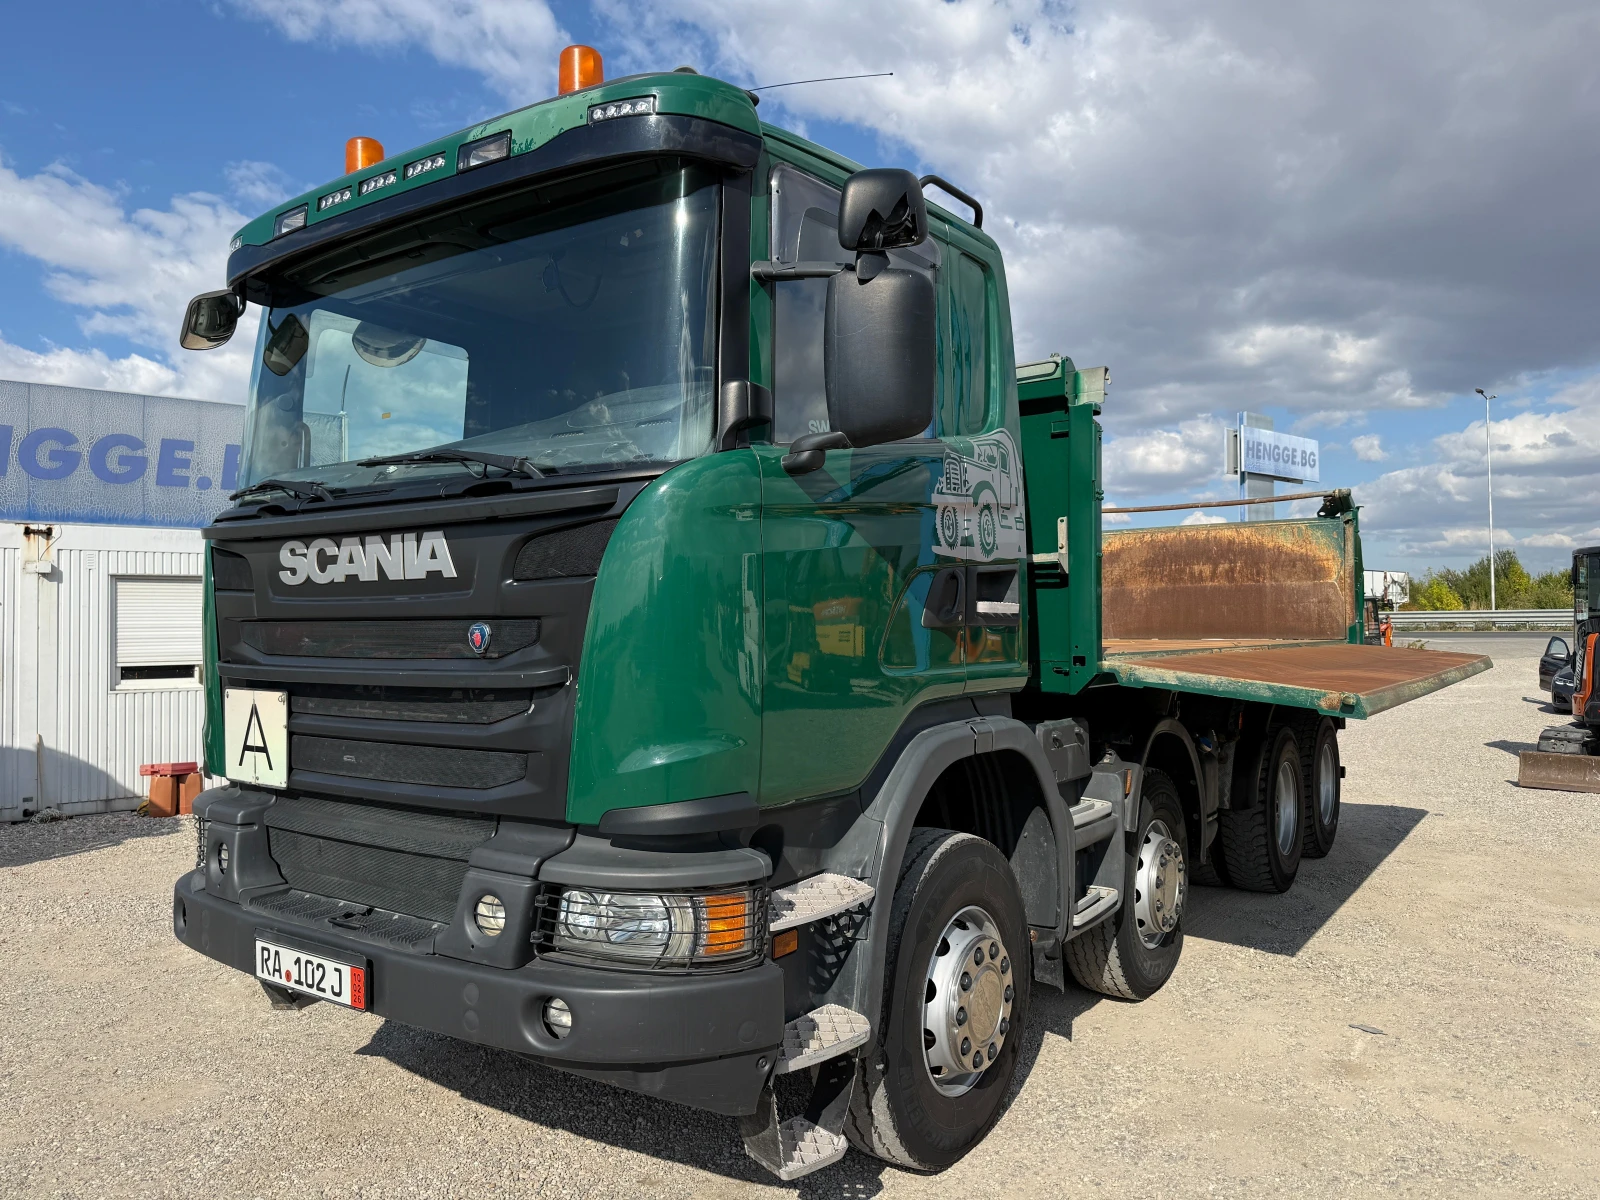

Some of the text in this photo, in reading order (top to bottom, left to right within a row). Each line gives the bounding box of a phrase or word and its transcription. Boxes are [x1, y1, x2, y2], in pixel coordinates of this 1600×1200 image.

[1246, 440, 1317, 468] HENGGE.BG
[278, 530, 458, 586] SCANIA
[238, 703, 273, 771] A
[261, 946, 342, 997] RA 102 J
[353, 972, 362, 983] 10
[352, 983, 362, 994] 02
[353, 994, 362, 1004] 26
